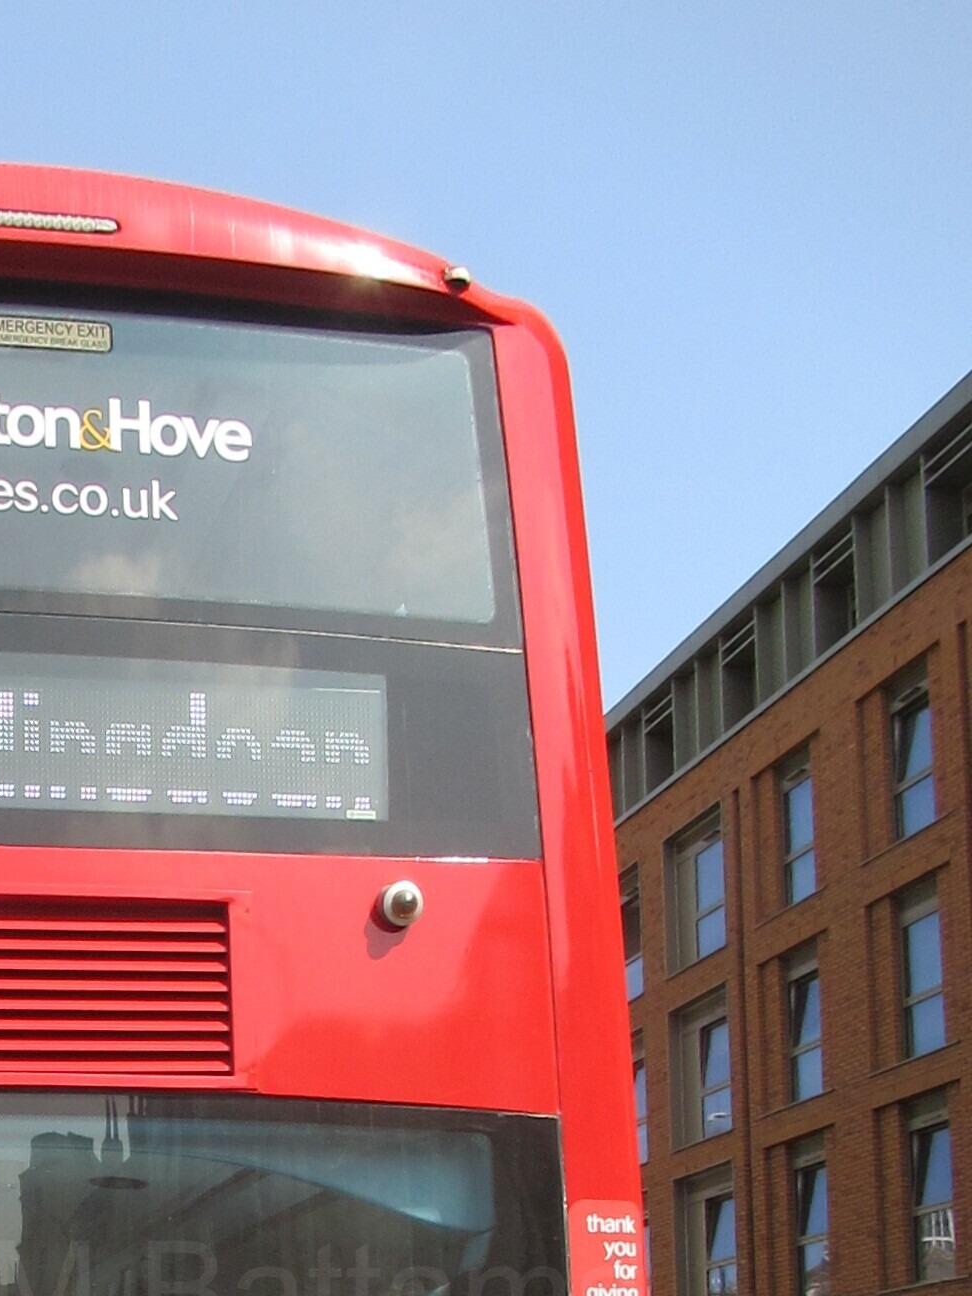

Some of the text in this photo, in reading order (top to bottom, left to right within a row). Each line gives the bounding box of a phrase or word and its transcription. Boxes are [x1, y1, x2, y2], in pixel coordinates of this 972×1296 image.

[77, 325, 107, 338] EXIT
[586, 1213, 636, 1234] thank
[604, 1240, 637, 1261] you
[614, 1259, 637, 1280] for
